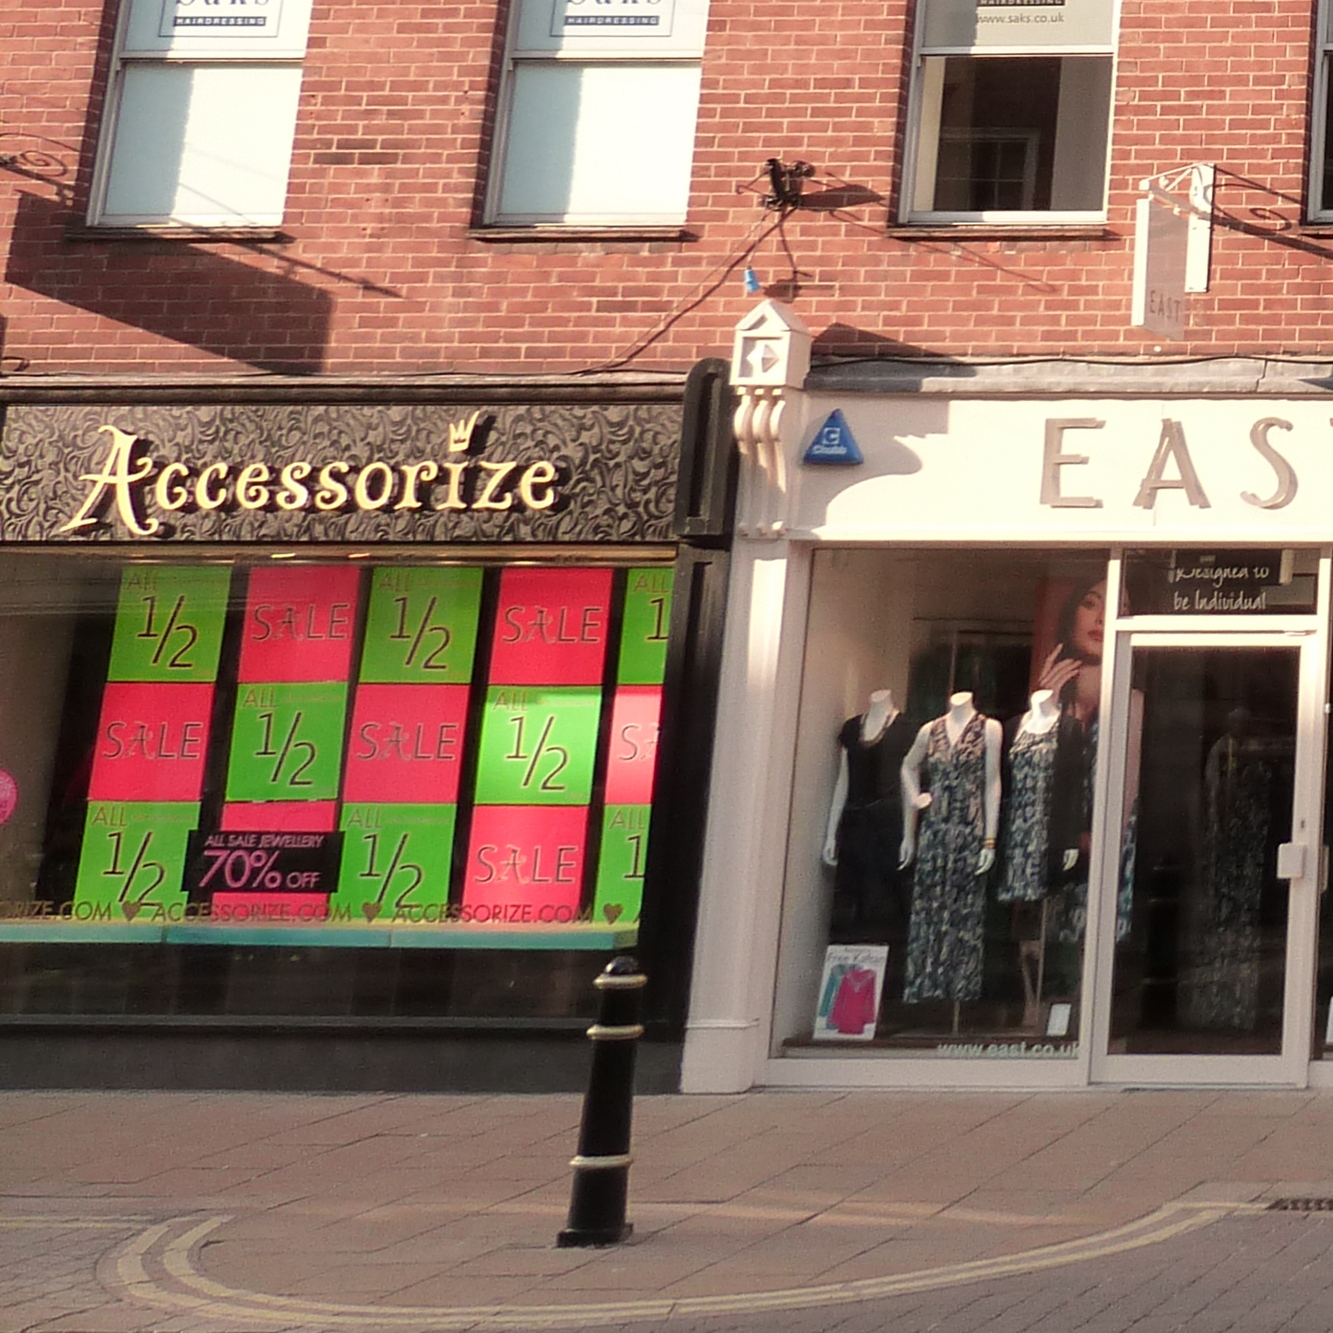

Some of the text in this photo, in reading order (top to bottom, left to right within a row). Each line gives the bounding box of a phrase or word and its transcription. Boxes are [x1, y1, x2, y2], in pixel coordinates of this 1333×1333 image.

[175, 16, 266, 26] HAIRDRESSING
[566, 16, 659, 25] HAIRDRESSING
[976, 12, 1065, 24] www.saks.co.uk
[1150, 290, 1181, 322] EAST
[59, 411, 556, 536] Accessorize
[1174, 590, 1267, 611] be Individual
[136, 594, 199, 669] 1/2
[251, 603, 349, 641] SALE
[389, 596, 451, 670] 1/2
[501, 606, 601, 643] SALE
[241, 688, 278, 709] ALL
[102, 721, 203, 759] SALE
[254, 711, 317, 787] 1/2
[356, 722, 458, 760] SALE
[503, 715, 569, 791] 1/2
[91, 806, 127, 827] ALL
[347, 807, 383, 829] ALL
[609, 808, 646, 830] ALL
[204, 834, 325, 848] ALL SALE JEWELLERY
[102, 831, 167, 906] 1/2
[198, 849, 321, 890] 70% OFF
[358, 832, 425, 910] 1/2
[474, 845, 579, 884] SALE
[151, 902, 351, 922] ACCESSORIZE.COM
[391, 903, 595, 923] ACCESSORIZE.COM
[937, 1041, 1081, 1057] www.east.co.uk
